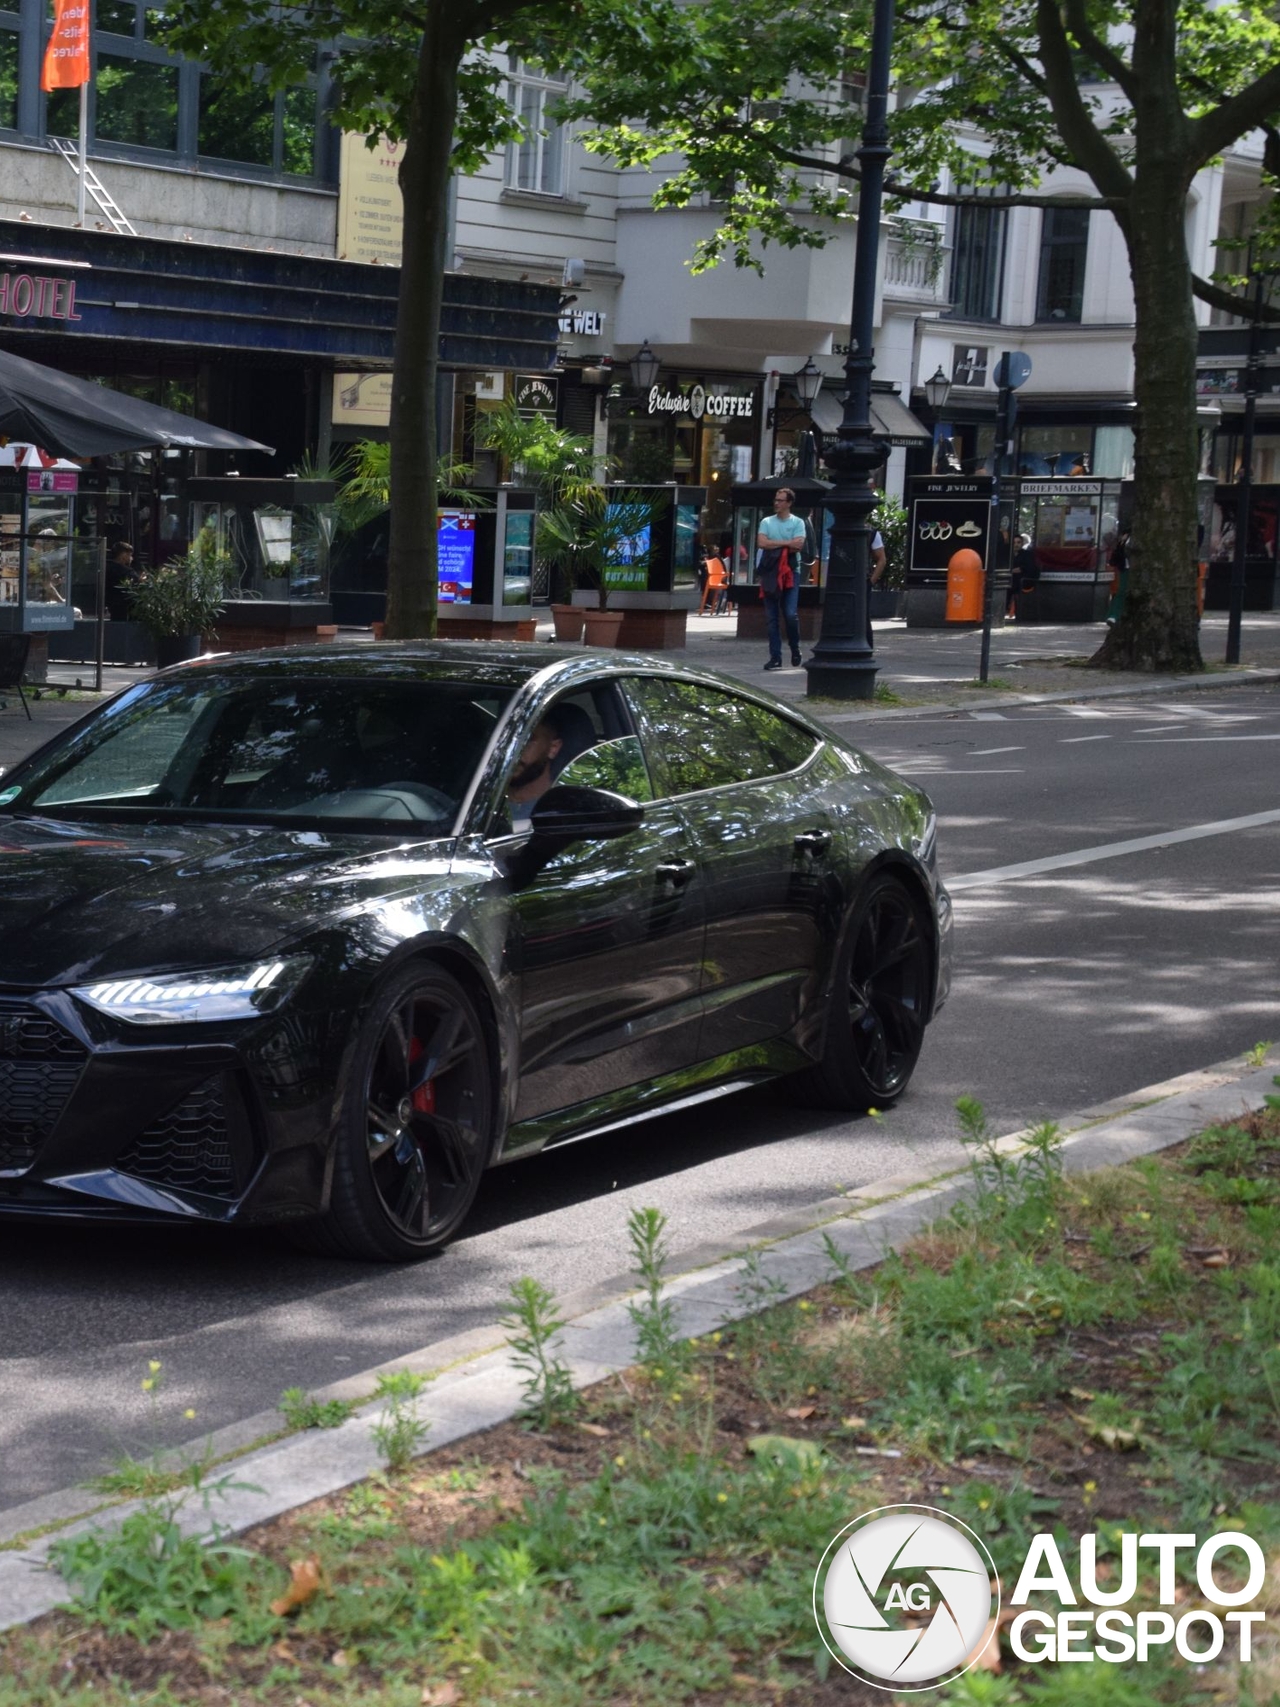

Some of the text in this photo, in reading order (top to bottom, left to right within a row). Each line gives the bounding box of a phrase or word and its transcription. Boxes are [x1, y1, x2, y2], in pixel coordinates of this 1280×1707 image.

[573, 310, 607, 336] WELT
[518, 381, 554, 404] FINE JEWELRY
[648, 384, 754, 417] Exclusive COFFEE
[1022, 484, 1100, 493] BRIEFMARKEN
